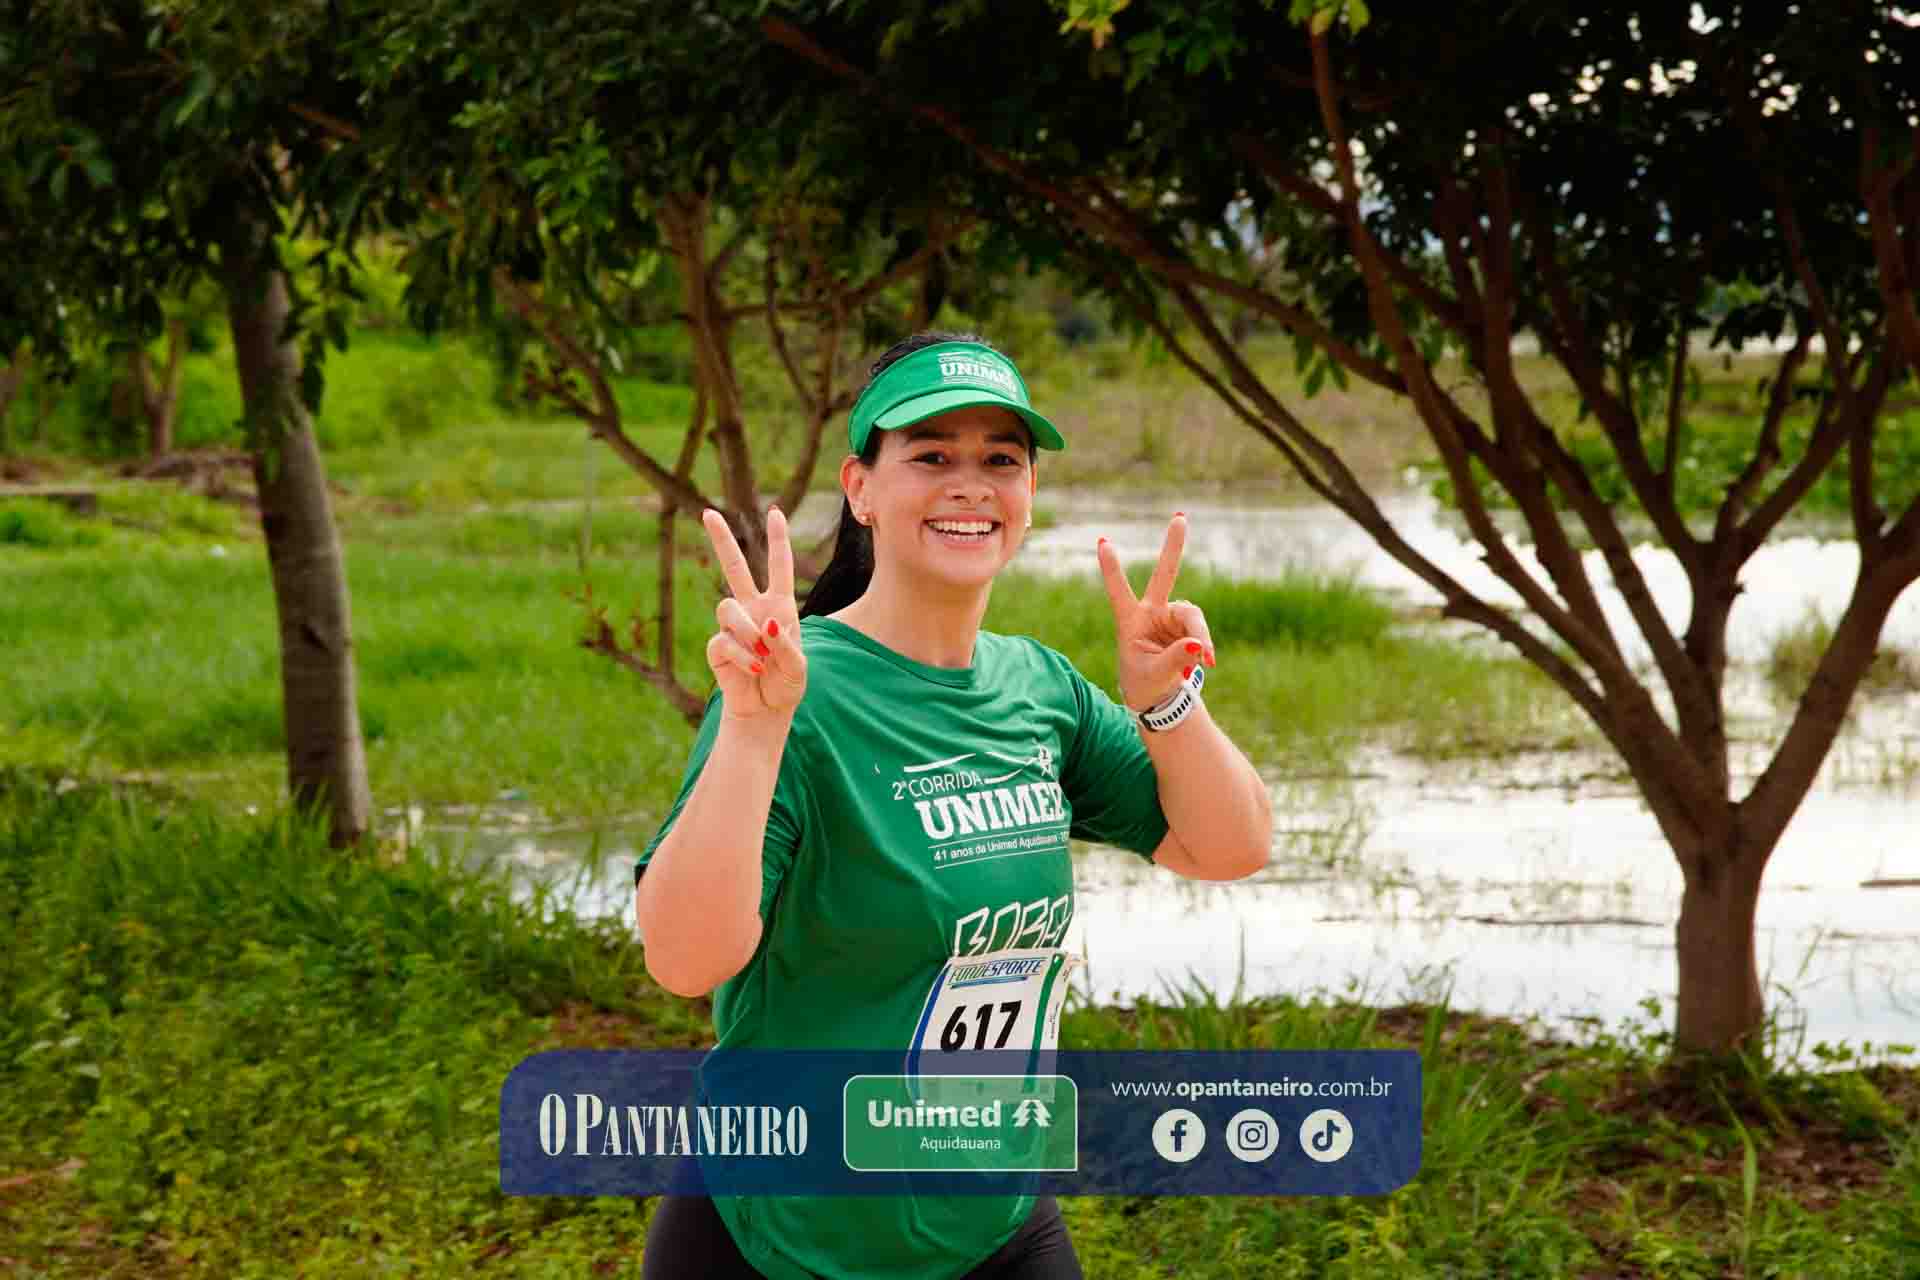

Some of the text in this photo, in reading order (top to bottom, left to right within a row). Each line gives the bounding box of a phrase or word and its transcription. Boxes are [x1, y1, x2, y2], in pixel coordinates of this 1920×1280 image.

[908, 771, 984, 798] CORRIDA
[933, 849, 947, 861] 41
[950, 846, 974, 859] anos
[975, 844, 986, 853] da
[987, 839, 1017, 852] Unimed
[940, 1000, 1022, 1053] 617
